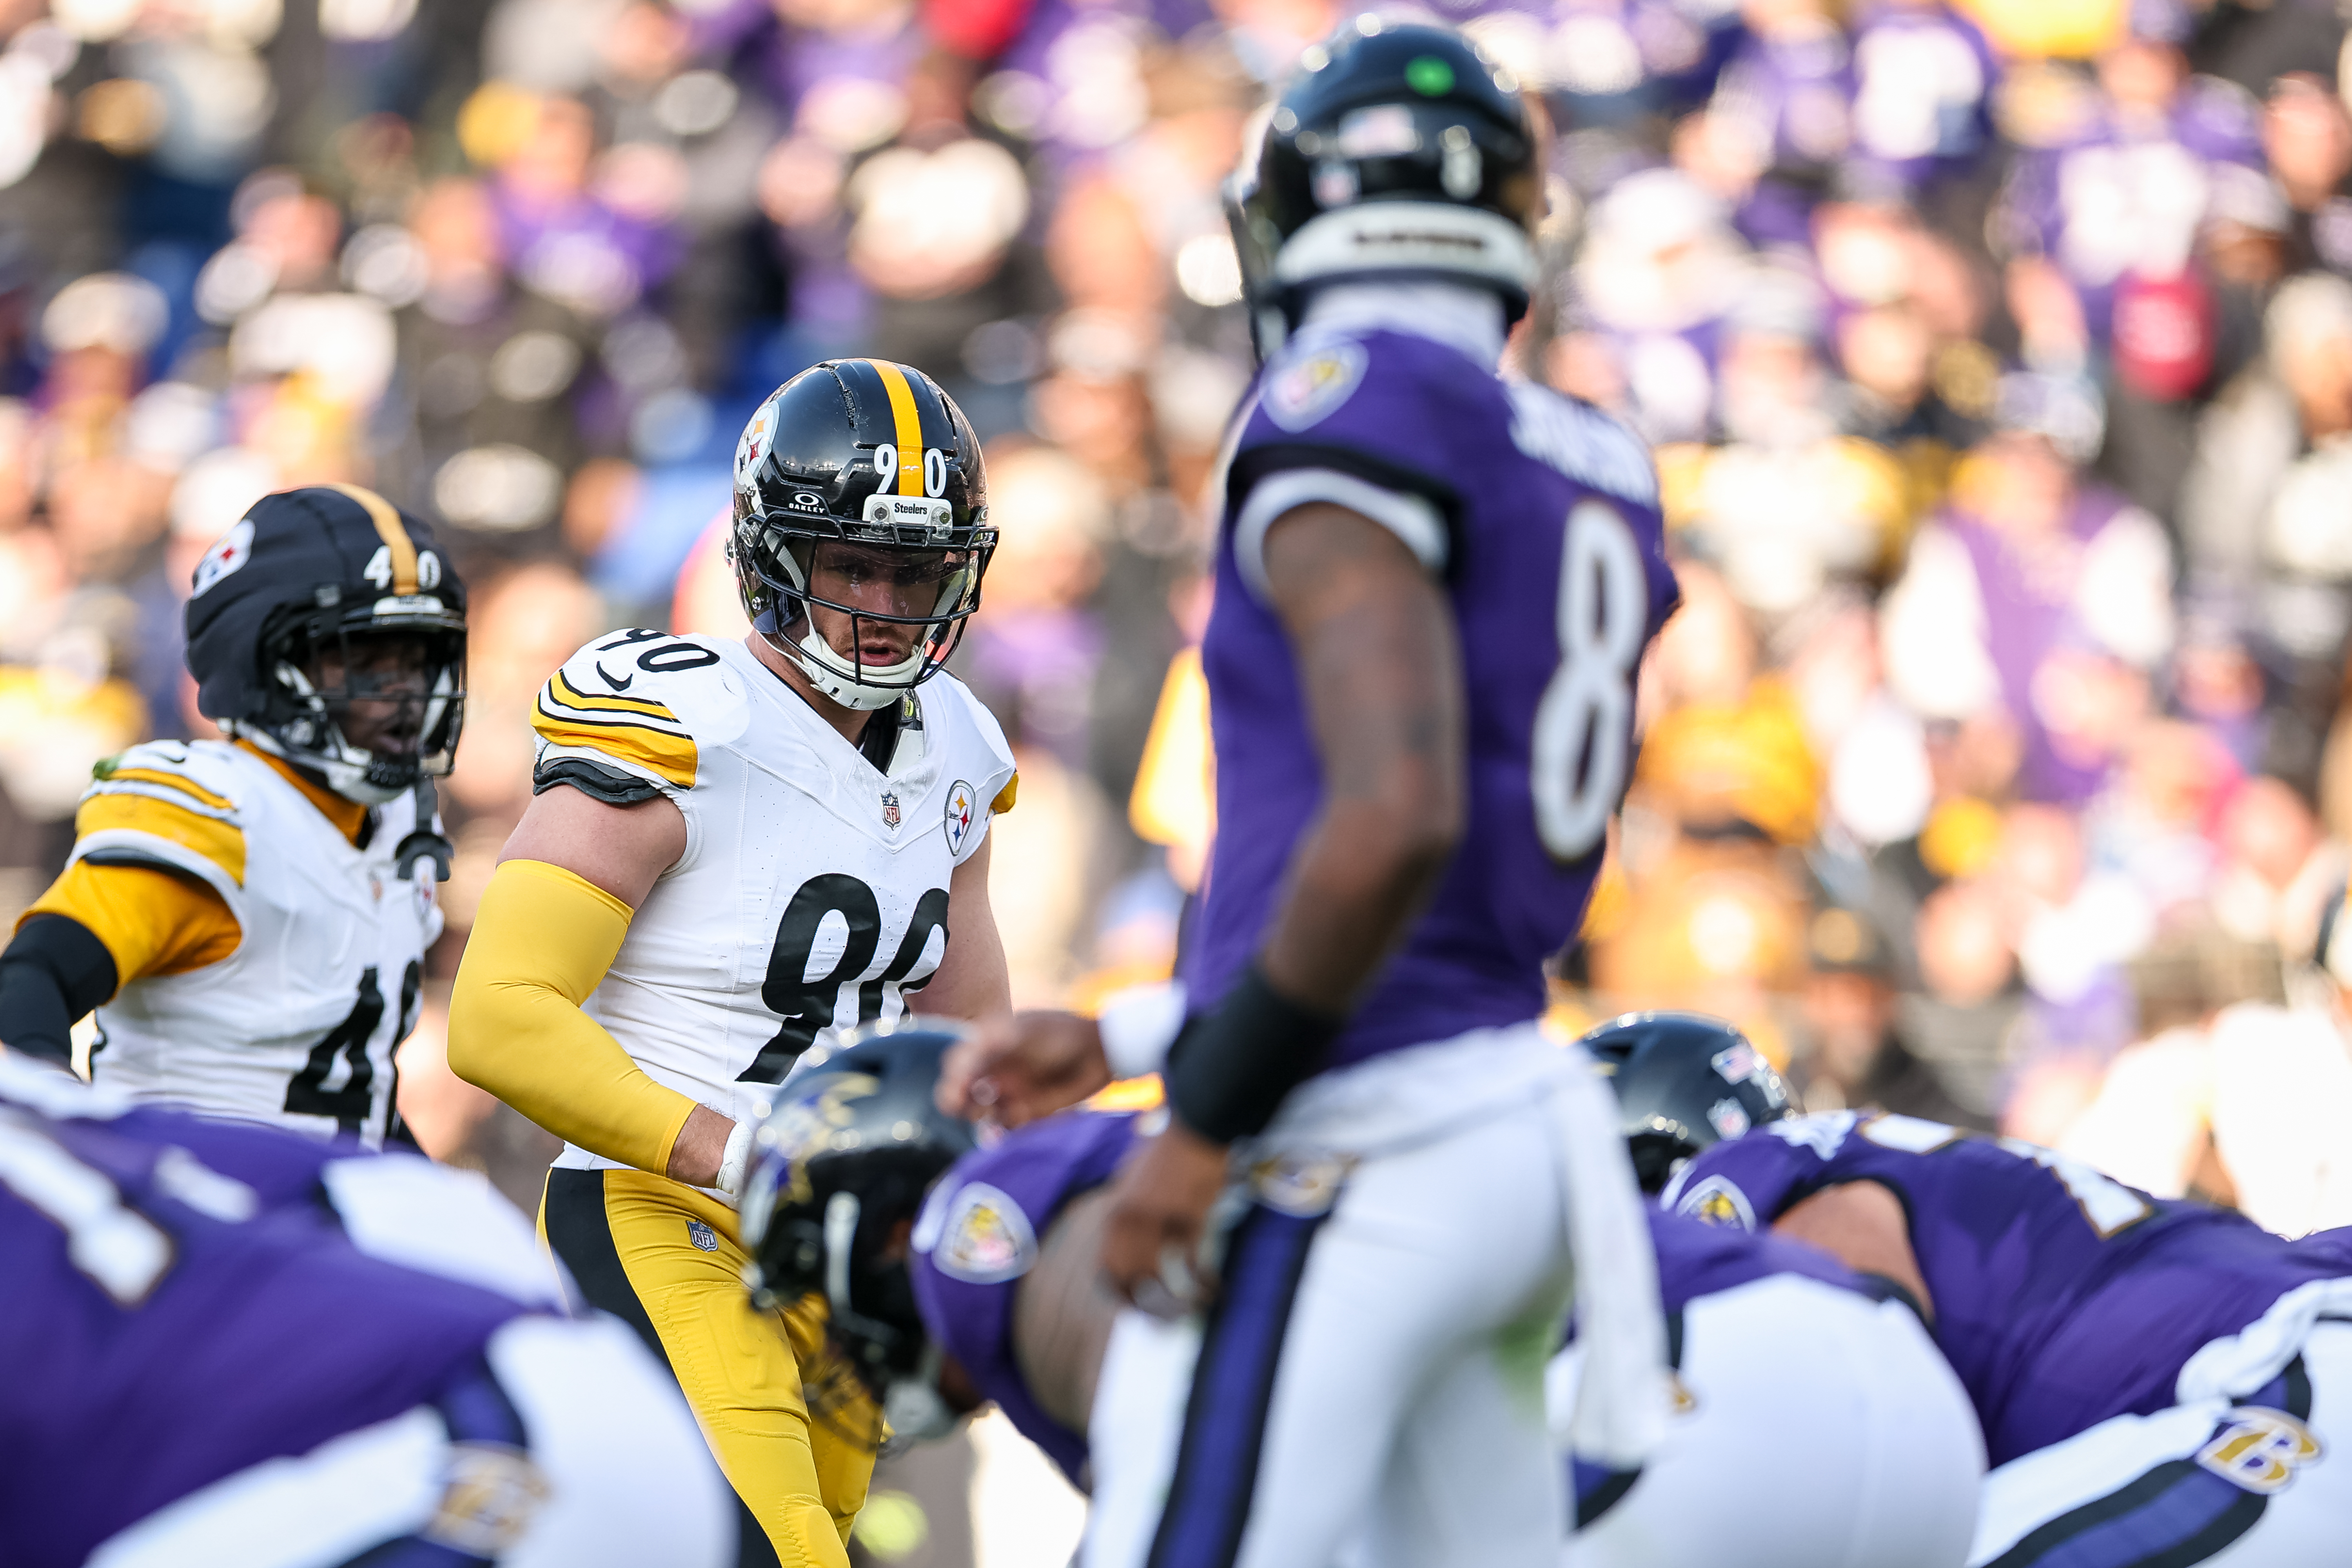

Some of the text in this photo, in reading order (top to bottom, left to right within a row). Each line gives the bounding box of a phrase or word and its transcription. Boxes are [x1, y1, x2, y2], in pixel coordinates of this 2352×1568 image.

[874, 444, 946, 497] 90
[789, 503, 824, 513] OAKLEY
[895, 503, 927, 515] Steelers
[363, 544, 441, 591] 40
[595, 628, 720, 672] 90
[1530, 499, 1646, 863] 8
[885, 807, 899, 822] NFL
[694, 1232, 715, 1247] NFL
